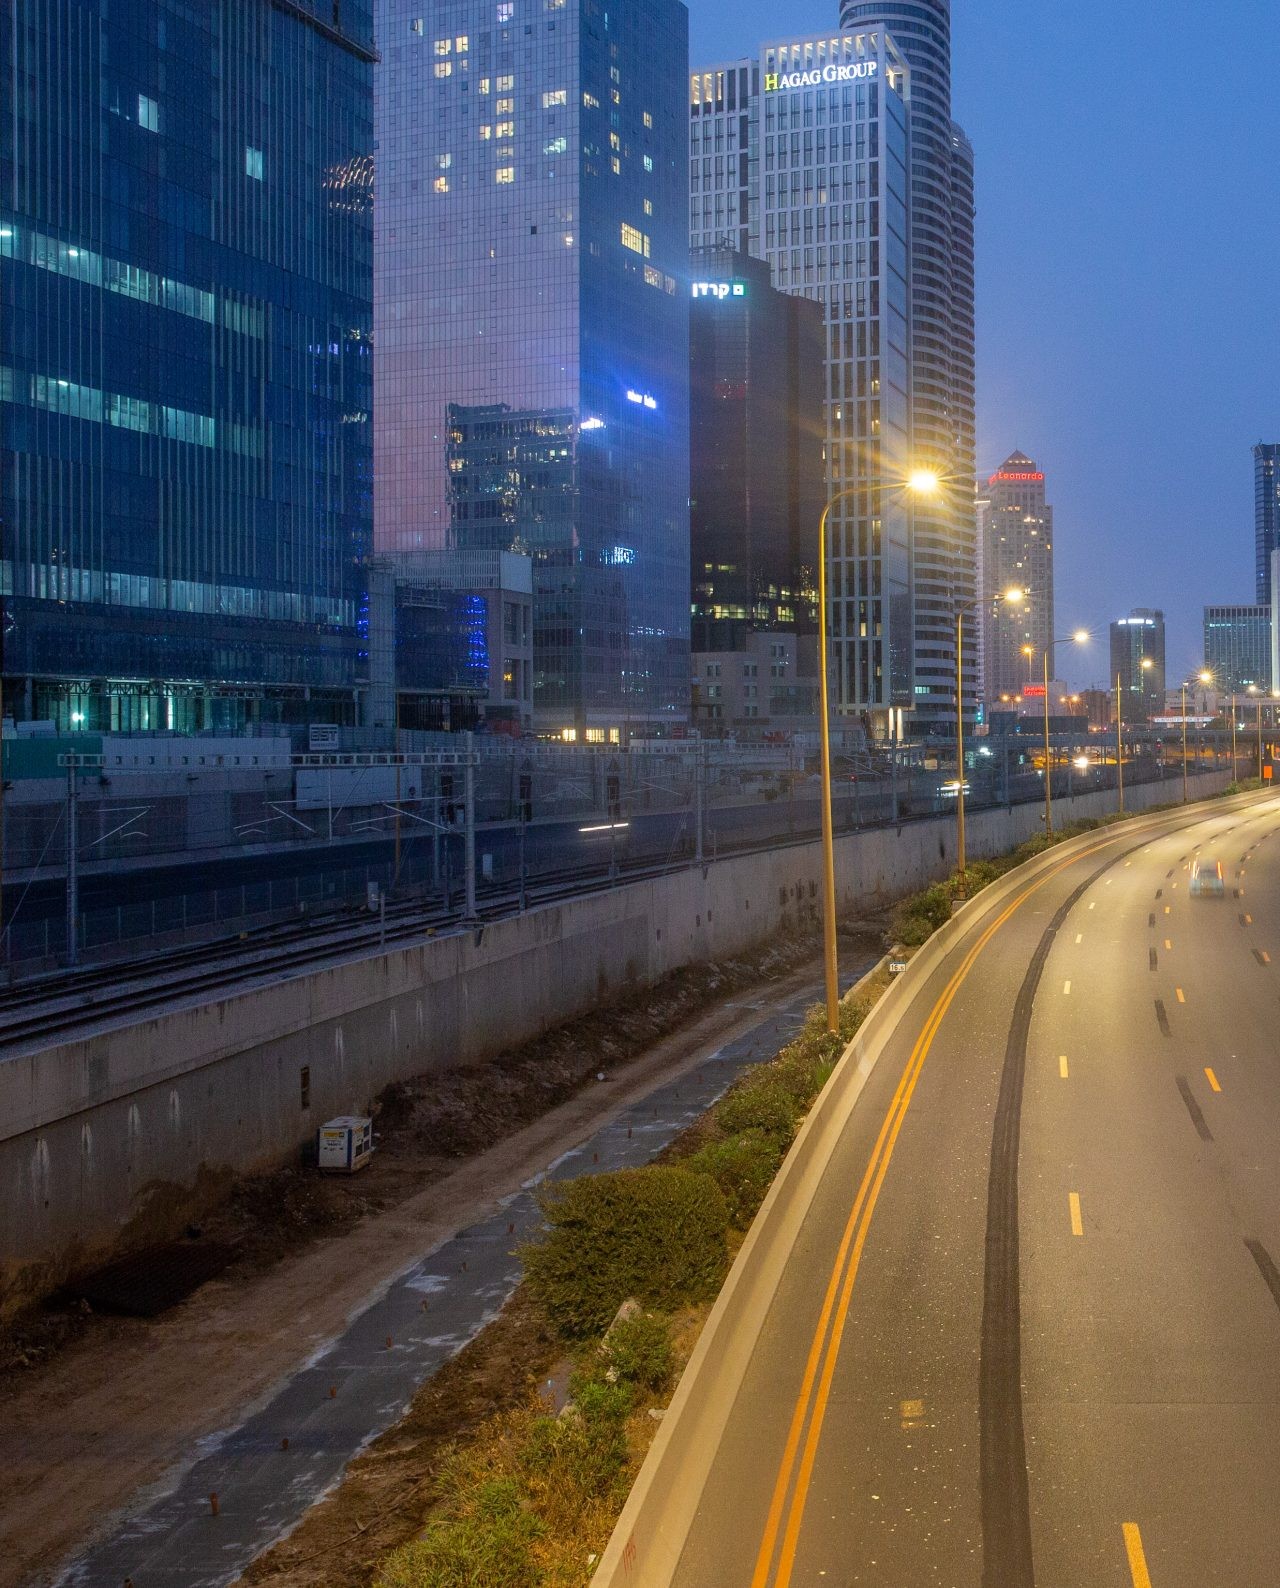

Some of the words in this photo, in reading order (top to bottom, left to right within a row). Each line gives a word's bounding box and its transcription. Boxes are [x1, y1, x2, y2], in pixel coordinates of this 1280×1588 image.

[764, 69, 821, 91] HAGAG
[822, 61, 877, 83] GROUP
[692, 283, 730, 299] קרדן
[998, 472, 1043, 481] Leonardo
